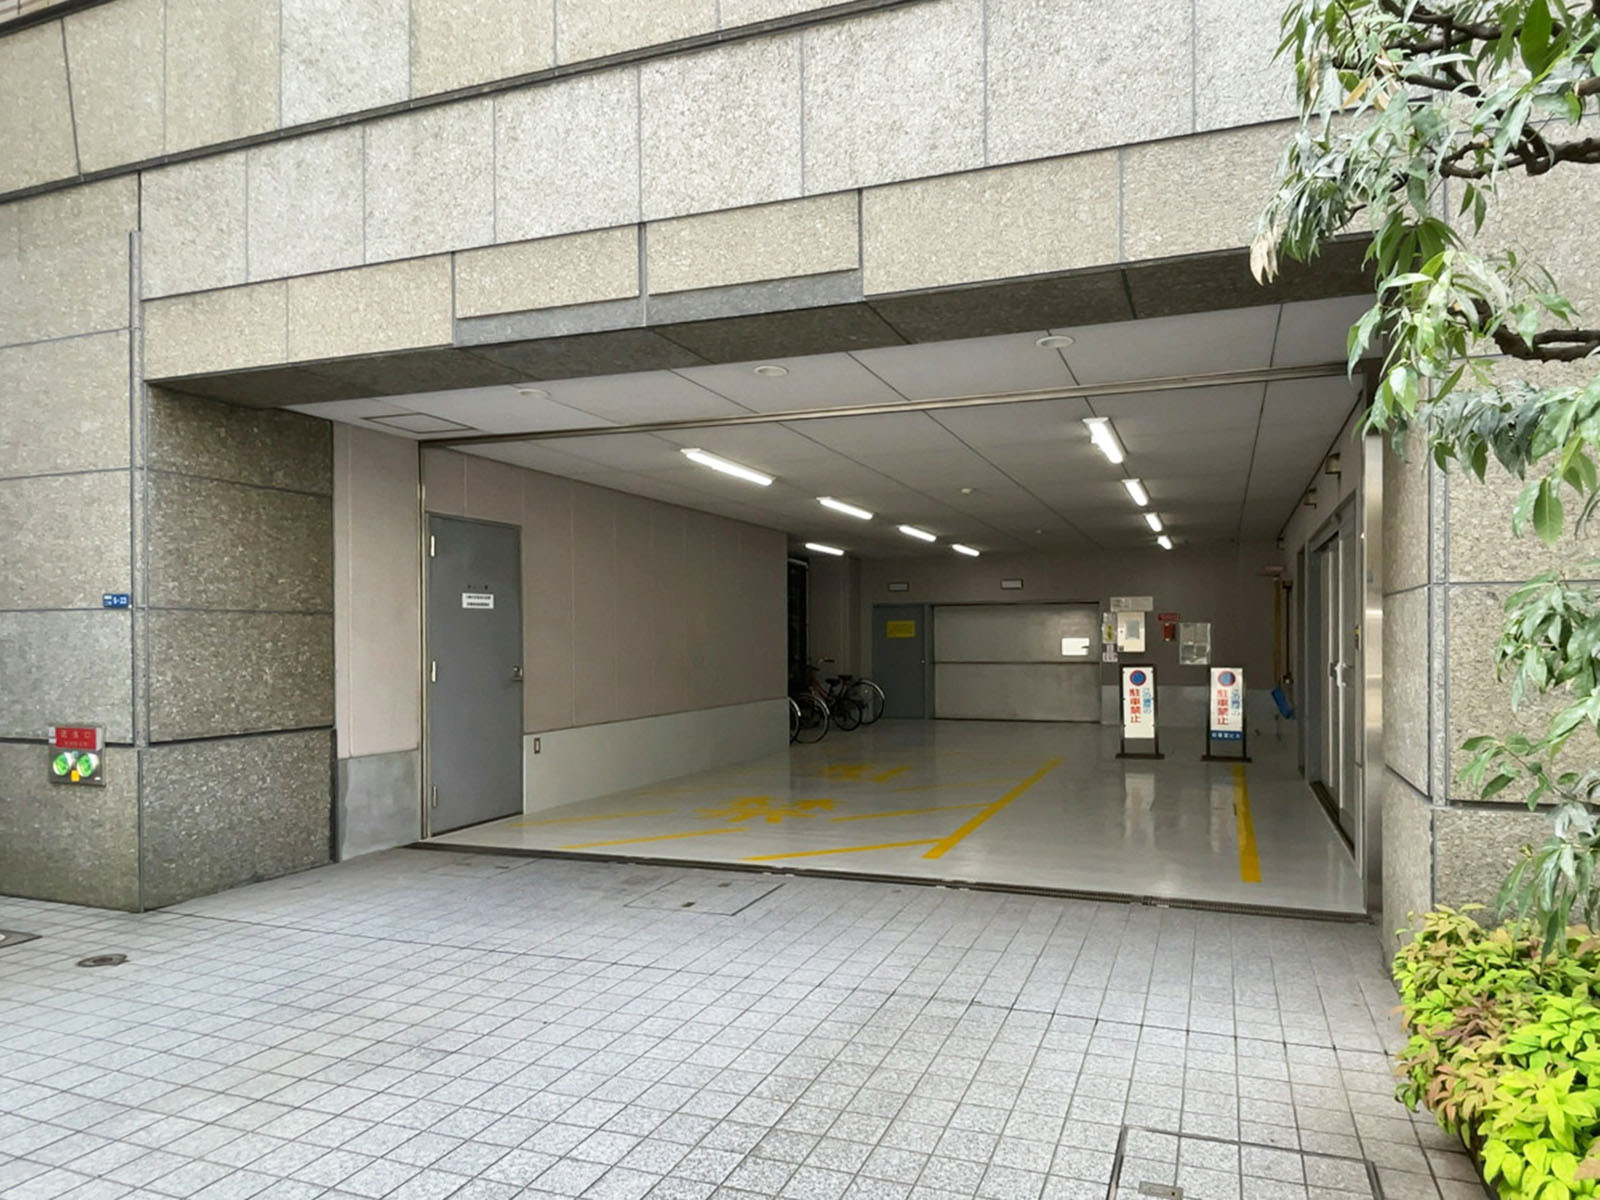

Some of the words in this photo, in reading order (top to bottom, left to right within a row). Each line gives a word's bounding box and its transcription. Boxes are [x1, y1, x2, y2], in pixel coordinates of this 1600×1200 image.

[1129, 688, 1141, 724] 駐車禁止
[1217, 689, 1229, 725] 駐車禁止
